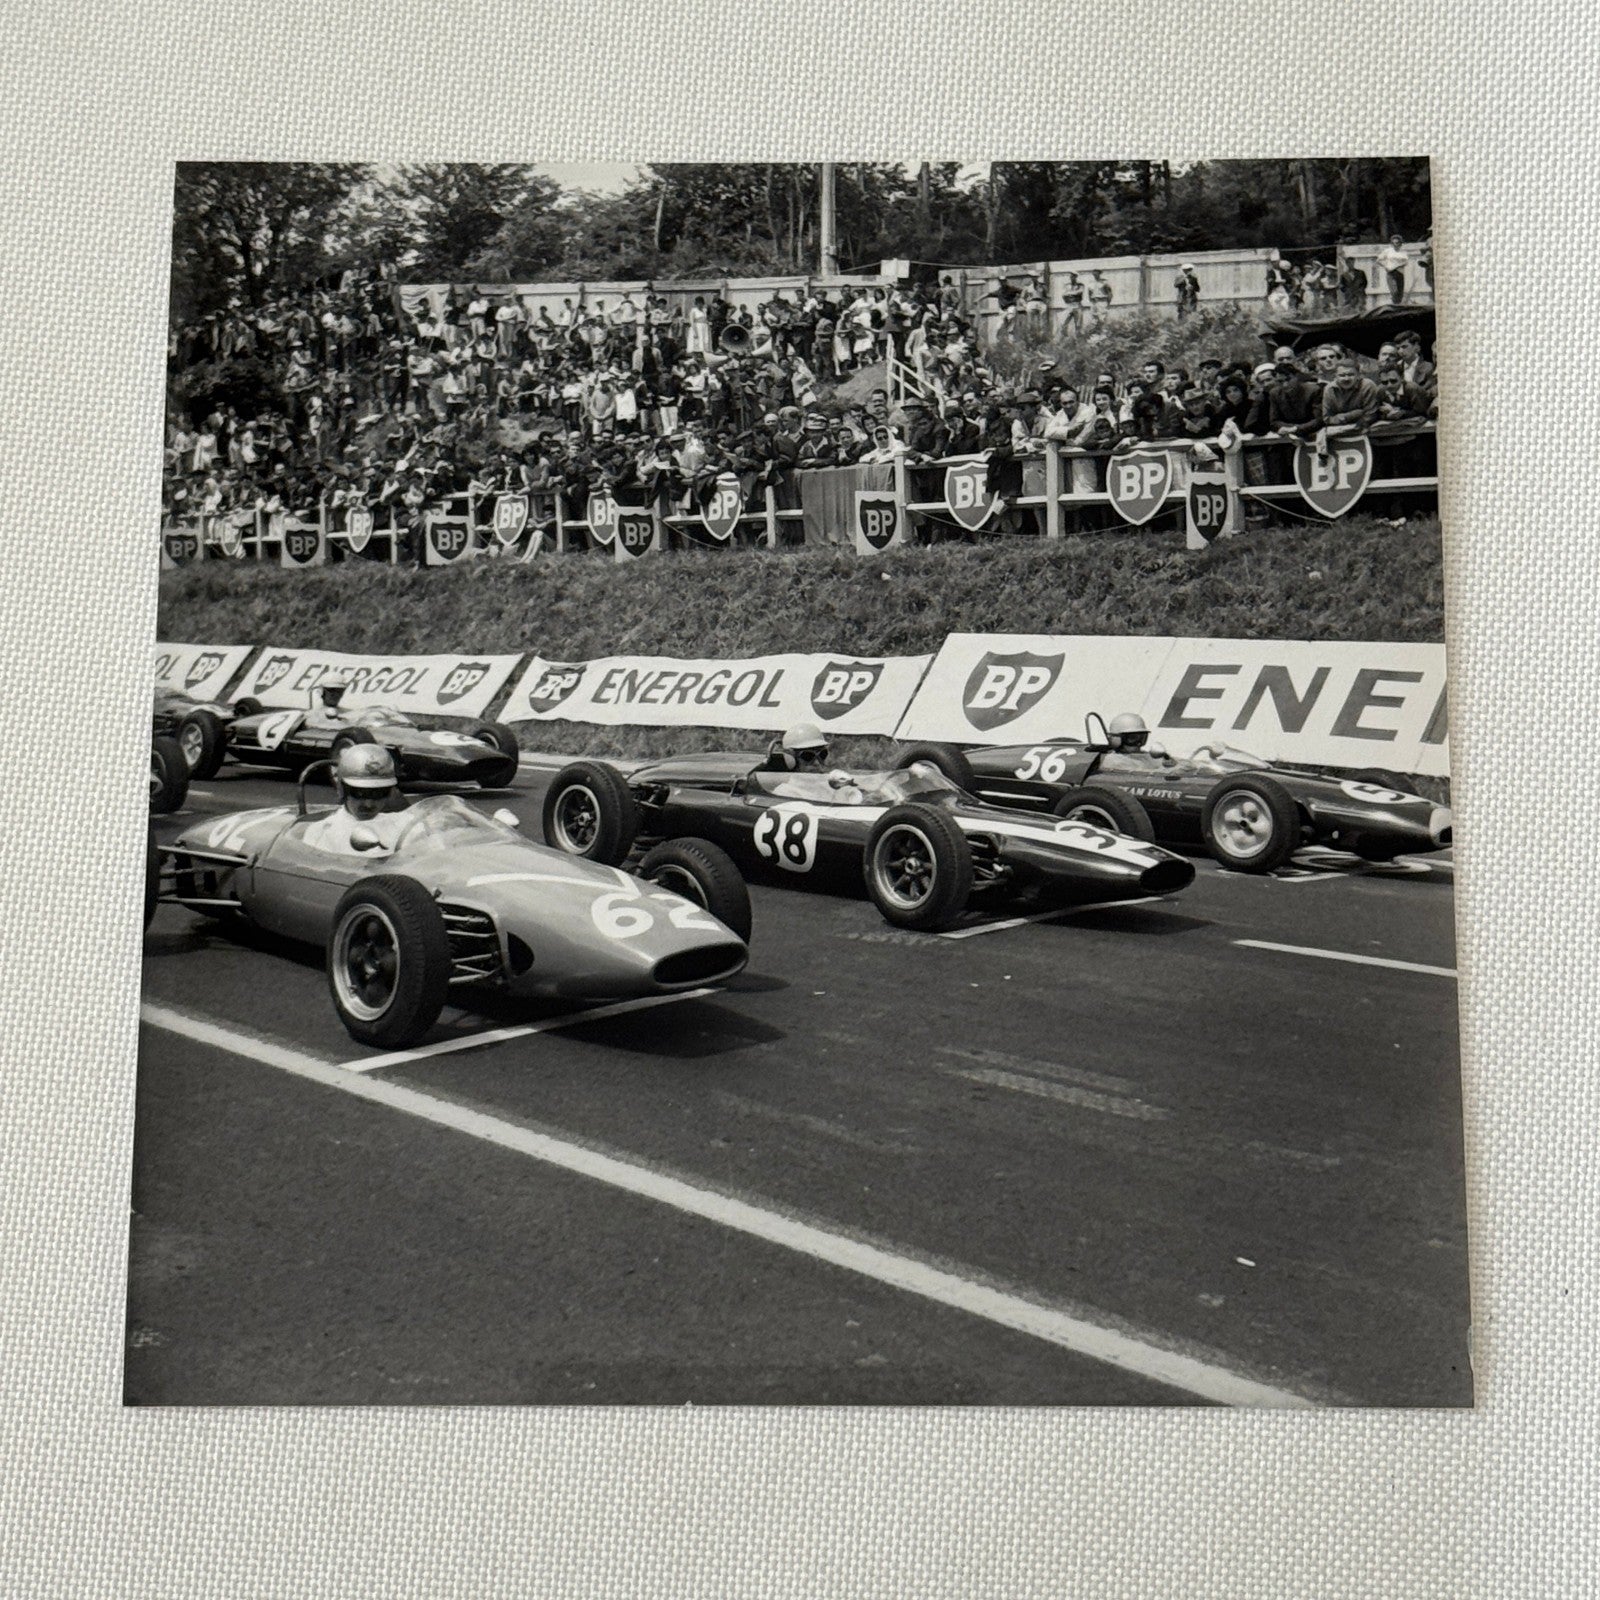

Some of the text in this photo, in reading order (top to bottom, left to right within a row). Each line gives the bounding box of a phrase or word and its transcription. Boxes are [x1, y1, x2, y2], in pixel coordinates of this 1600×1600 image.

[1117, 463, 1165, 500] BP
[1309, 450, 1363, 492] BP
[499, 503, 525, 528] BP
[707, 490, 738, 521] BP
[1197, 495, 1224, 527] BP
[351, 512, 371, 536] BP
[624, 522, 651, 546] BP
[866, 510, 893, 536] BP
[170, 540, 196, 558] BP
[291, 536, 316, 555] BP
[437, 529, 465, 550] BP
[187, 657, 220, 680] BP
[256, 660, 290, 686] BP
[442, 670, 481, 695] BP
[530, 668, 873, 708] BP ENERGOL BP
[966, 665, 1051, 710] BP
[1014, 746, 1077, 782] 56
[1147, 788, 1182, 799] LOTUS
[759, 809, 810, 866] 38
[591, 892, 723, 938] 62
